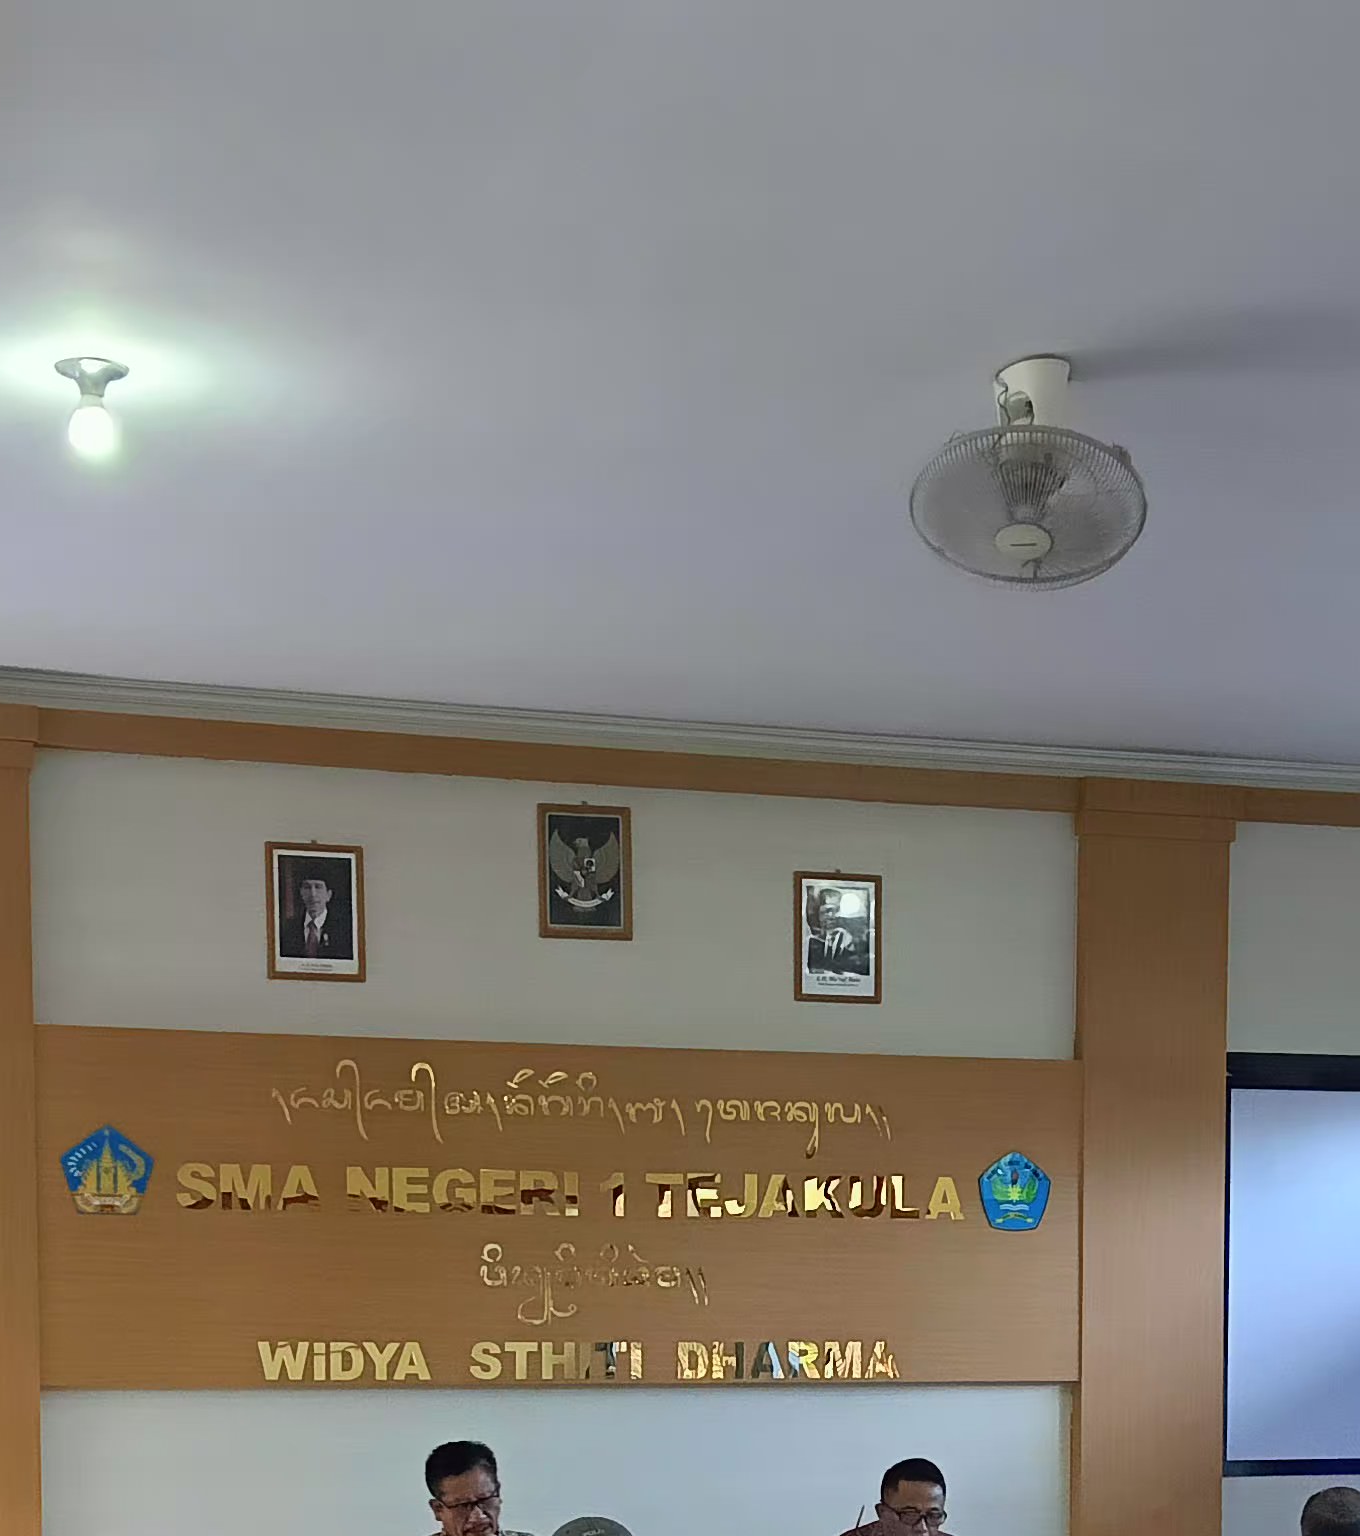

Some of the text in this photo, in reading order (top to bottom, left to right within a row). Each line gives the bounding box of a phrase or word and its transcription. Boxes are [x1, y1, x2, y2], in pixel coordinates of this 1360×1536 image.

[176, 1162, 966, 1221] SMA NEGERI 1 TEJAKULA
[469, 1340, 643, 1381] STHITI
[677, 1340, 902, 1380] DHARMA
